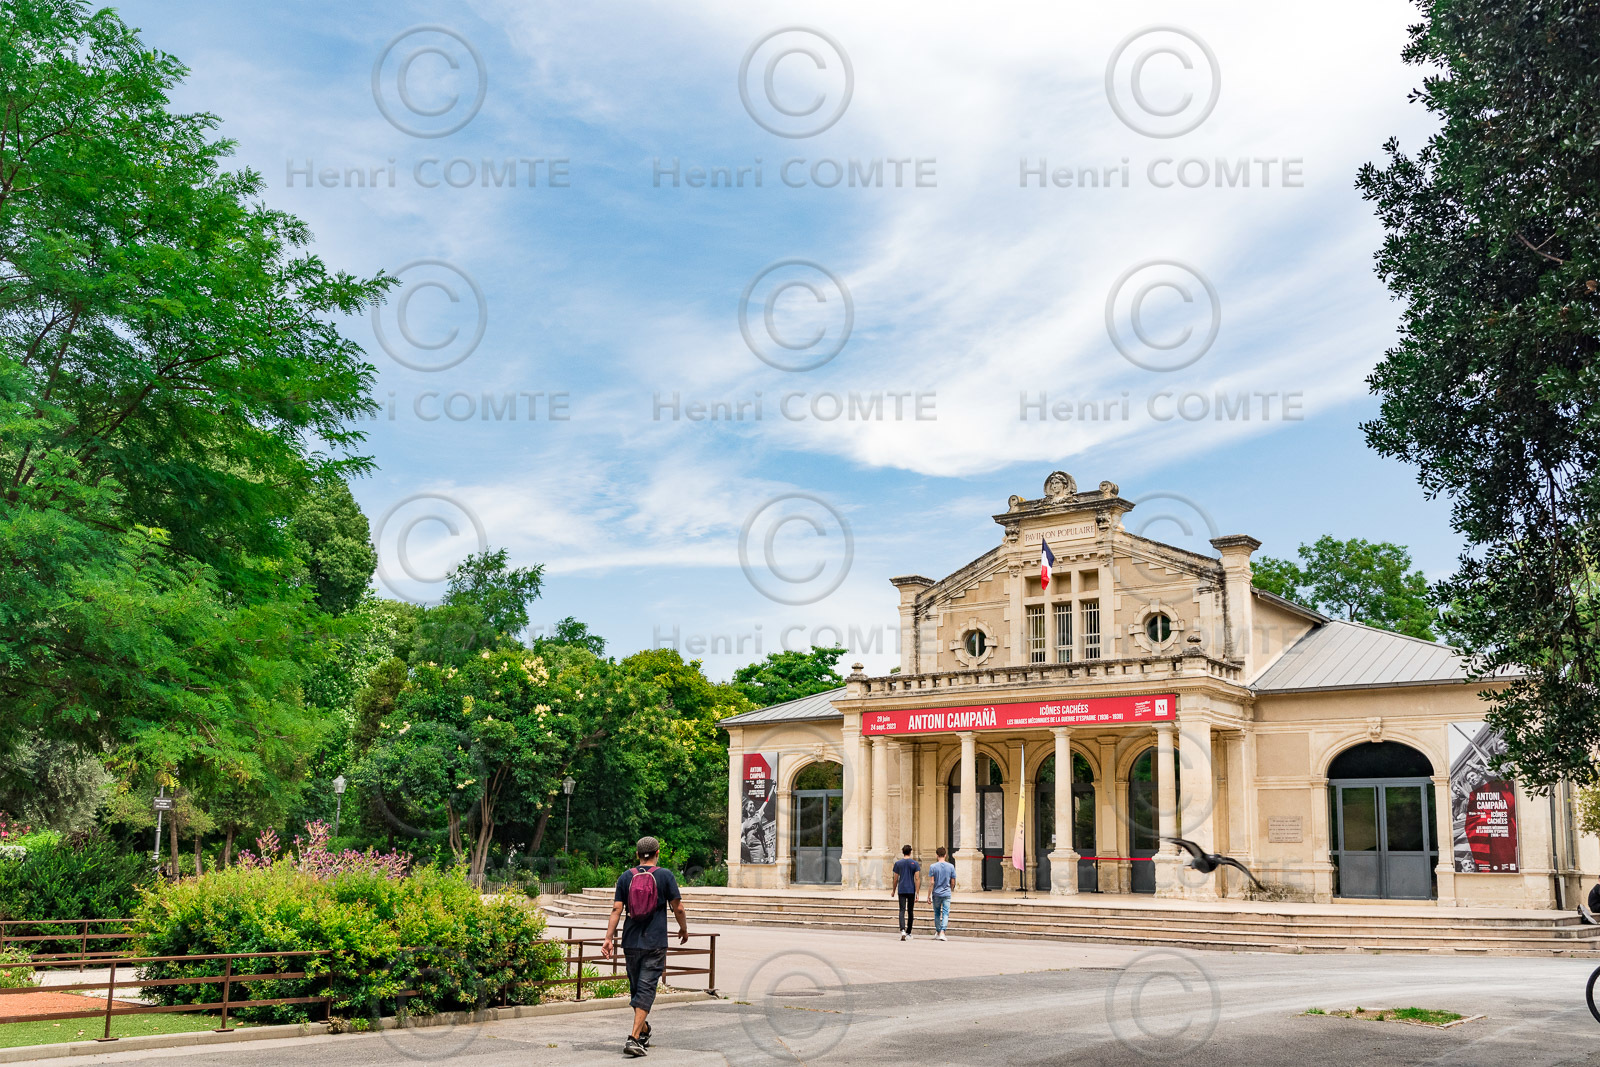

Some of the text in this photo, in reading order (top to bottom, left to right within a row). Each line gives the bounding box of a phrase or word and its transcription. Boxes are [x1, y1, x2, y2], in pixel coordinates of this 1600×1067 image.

[1057, 525, 1094, 537] POPULAIRE
[1040, 702, 1089, 716] ICÔNES CACHÉES
[908, 707, 997, 730] ANTONI CAMPAÑÀ
[1476, 792, 1500, 800] ANTONI
[1476, 799, 1508, 809] CAMPAÑÀ
